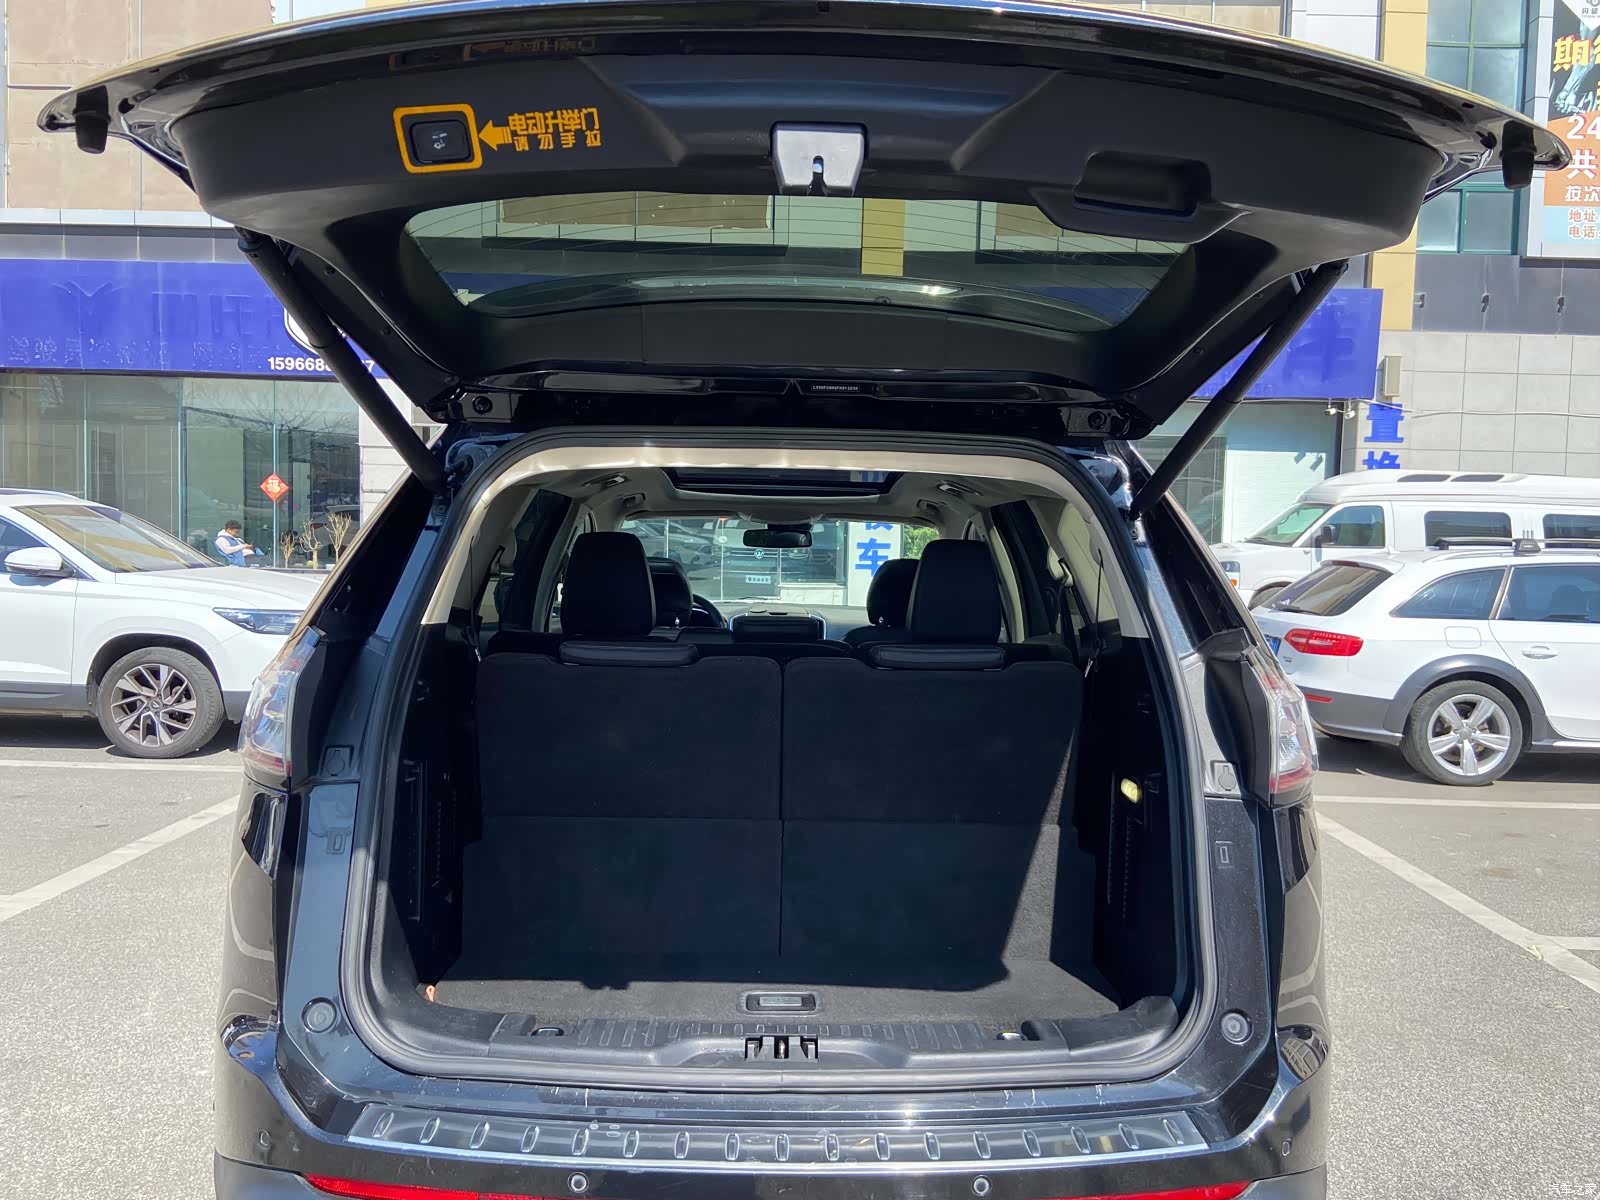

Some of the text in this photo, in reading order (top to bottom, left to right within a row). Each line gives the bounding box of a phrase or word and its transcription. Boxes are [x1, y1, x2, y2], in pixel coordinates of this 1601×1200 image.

[508, 108, 599, 134] 电动升举门
[1567, 114, 1600, 140] 24
[514, 130, 601, 151] 请勿手拉
[1566, 149, 1597, 180] 共
[1568, 209, 1597, 223] 地址
[1568, 225, 1597, 239] 电话
[267, 357, 375, 374] 1596687
[854, 522, 894, 578] 车
